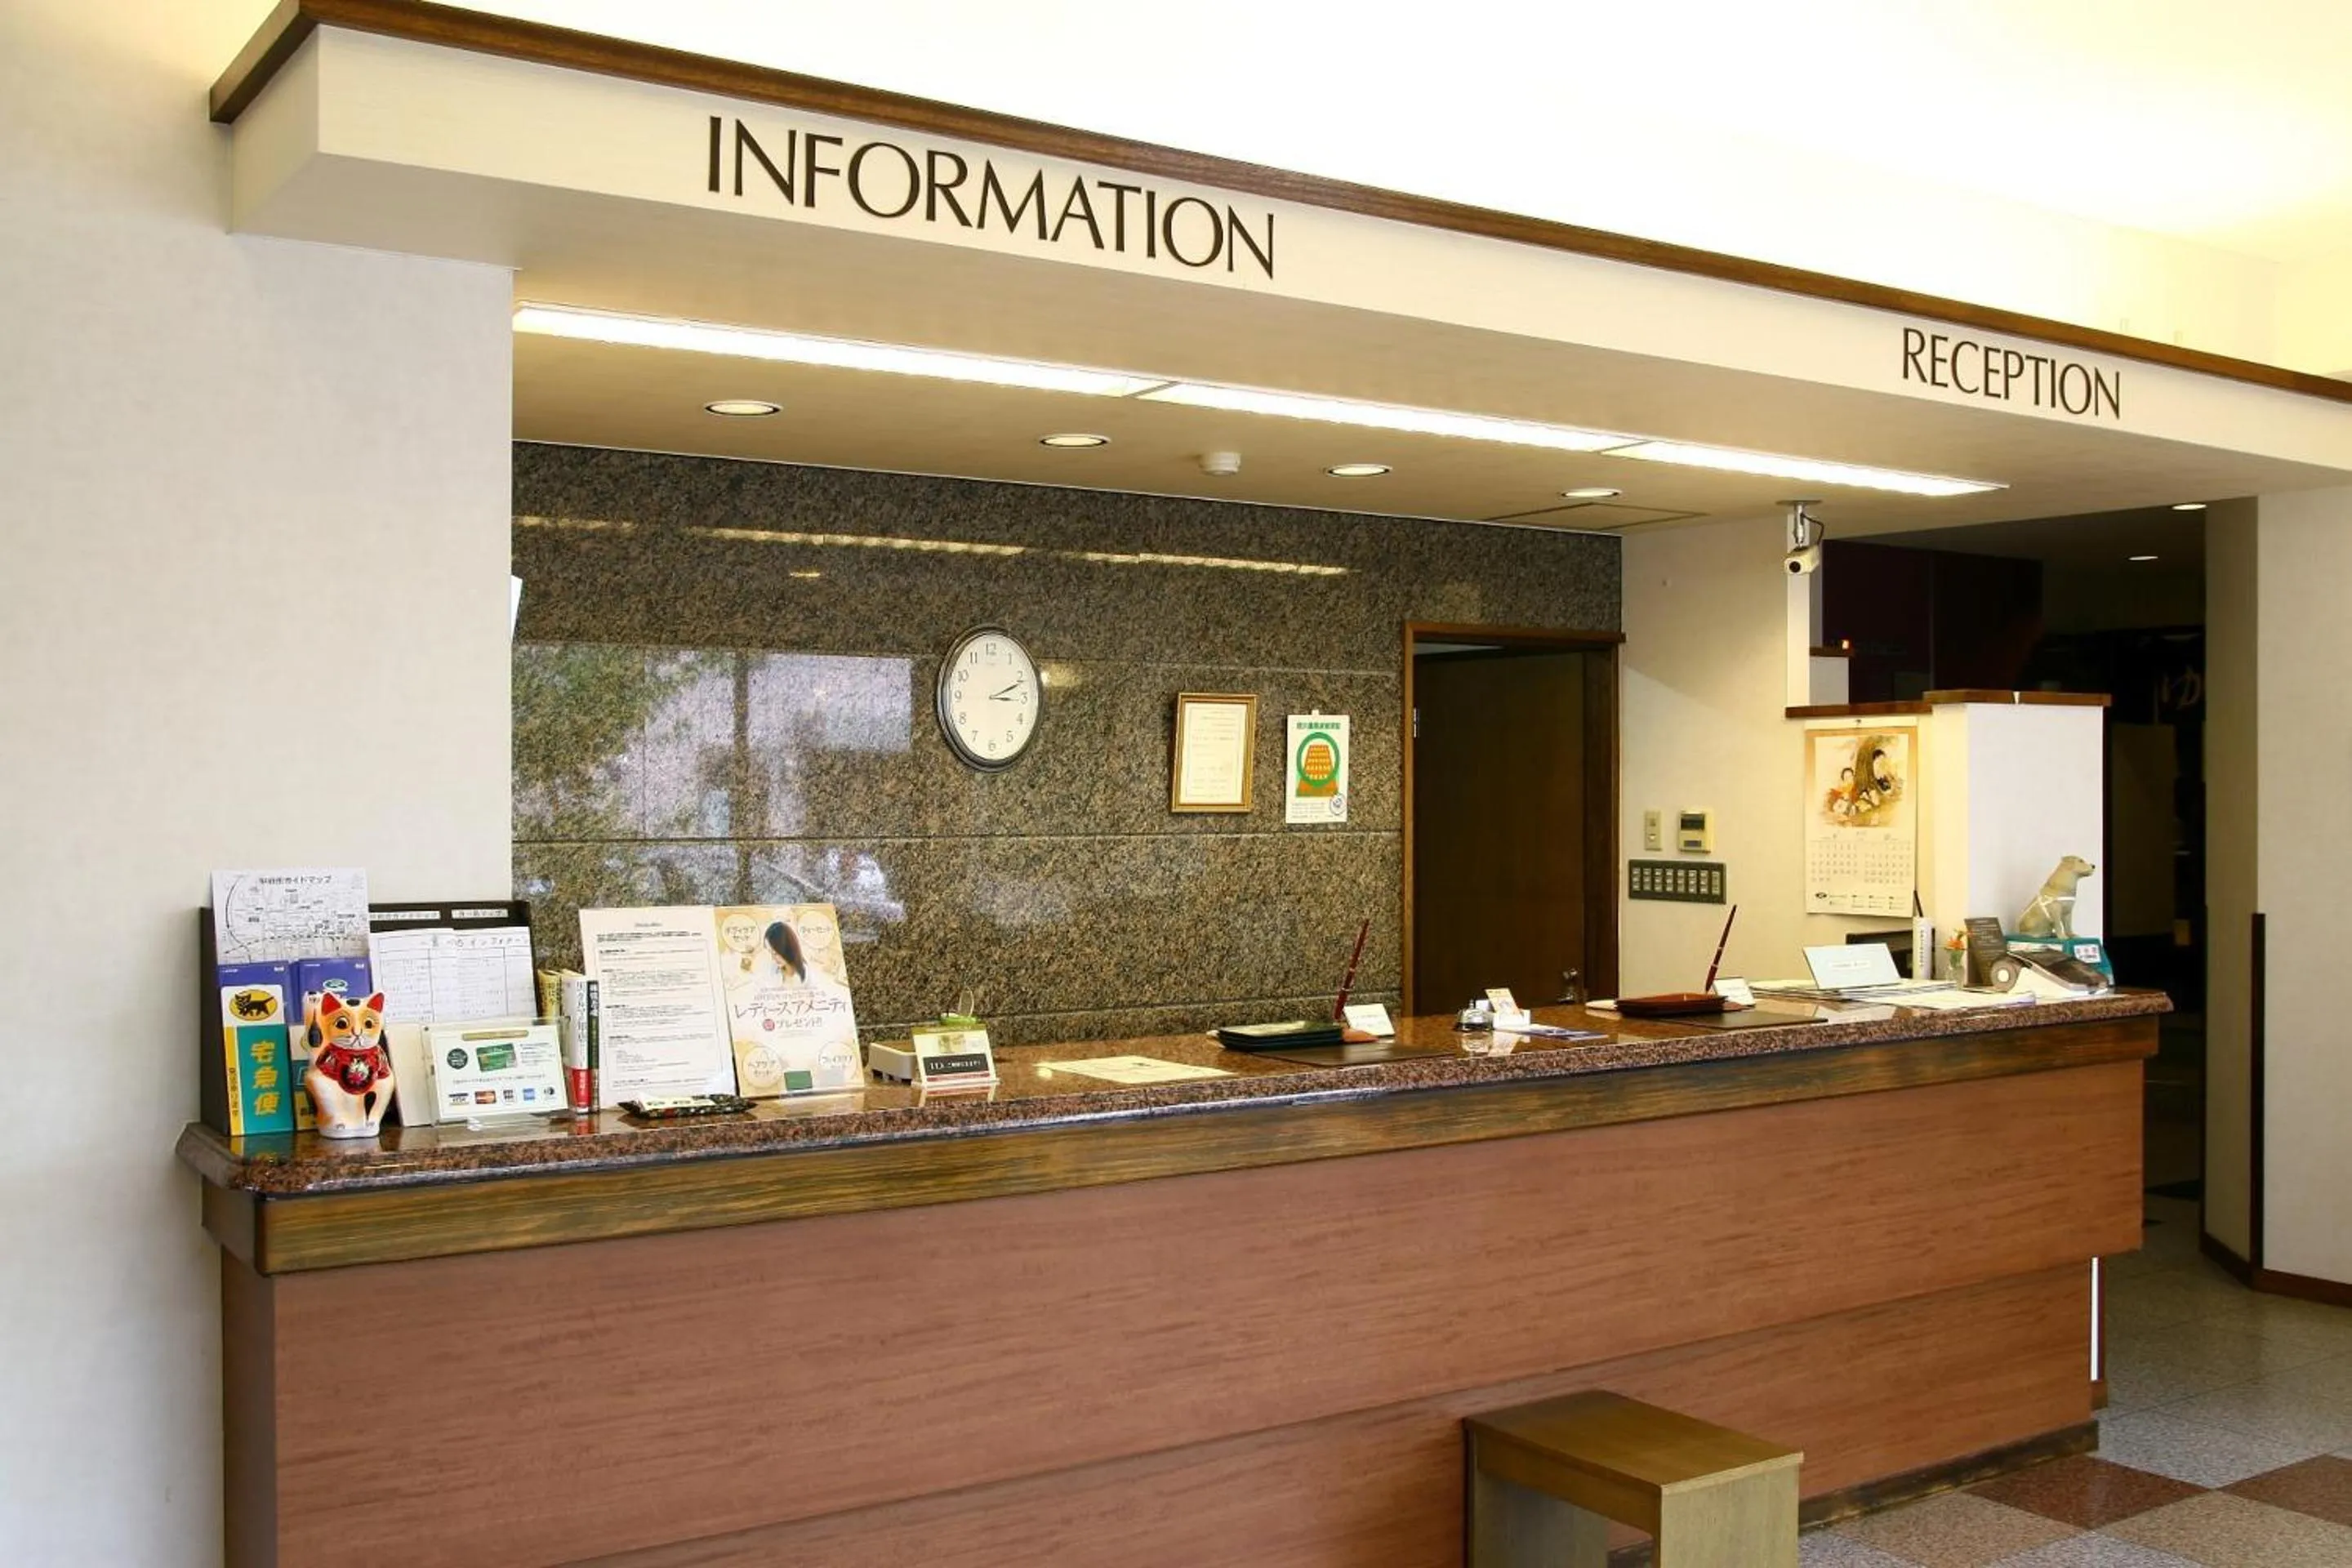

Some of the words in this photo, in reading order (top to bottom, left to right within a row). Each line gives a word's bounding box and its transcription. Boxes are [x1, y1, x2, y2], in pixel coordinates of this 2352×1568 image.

[708, 116, 1274, 279] INFORMATION
[1902, 327, 2120, 420] RECEPTION
[986, 643, 997, 655] 12
[969, 652, 978, 664] 11
[957, 669, 969, 682] 10
[1017, 670, 1025, 682] 2
[954, 690, 962, 702] 9
[1021, 692, 1028, 704] 3
[959, 712, 966, 724] 8
[1016, 713, 1023, 724] 4
[972, 730, 978, 742] 7
[1006, 730, 1013, 742] 5
[988, 740, 996, 751] 6
[733, 997, 847, 1019] レディースアメニティ
